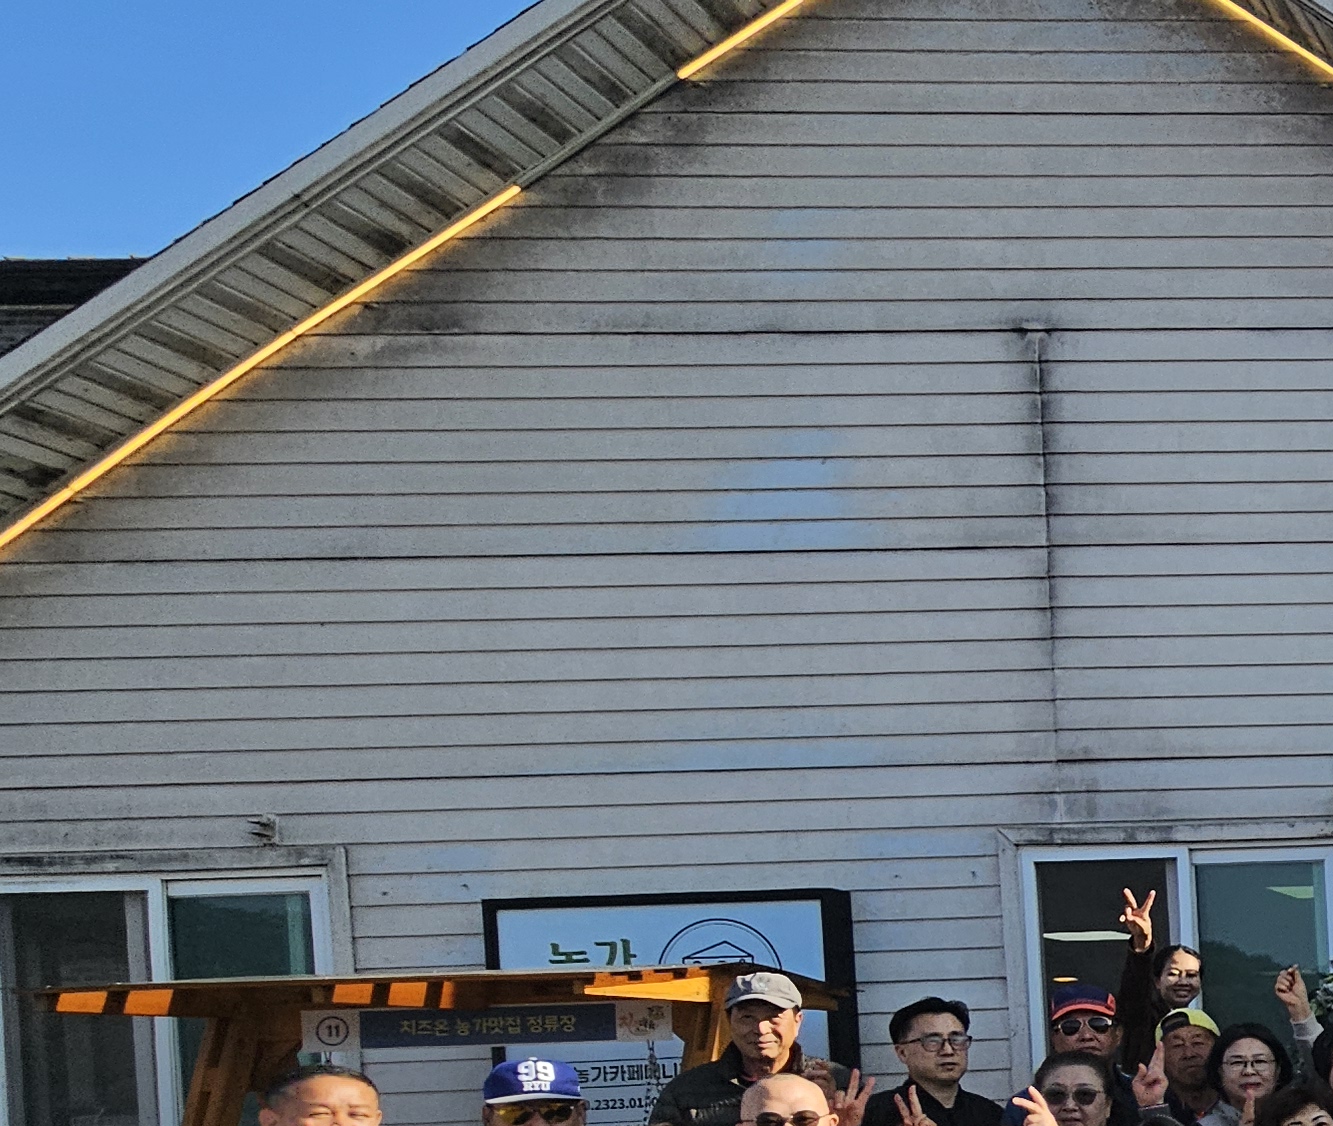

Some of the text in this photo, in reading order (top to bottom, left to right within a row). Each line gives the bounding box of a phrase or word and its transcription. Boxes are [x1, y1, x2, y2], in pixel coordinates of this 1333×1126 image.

[324, 1024, 341, 1038] 11
[400, 1013, 577, 1037] 치즈온 농가맛집 정류장
[517, 1060, 556, 1082] 99
[522, 1081, 551, 1091] RYU
